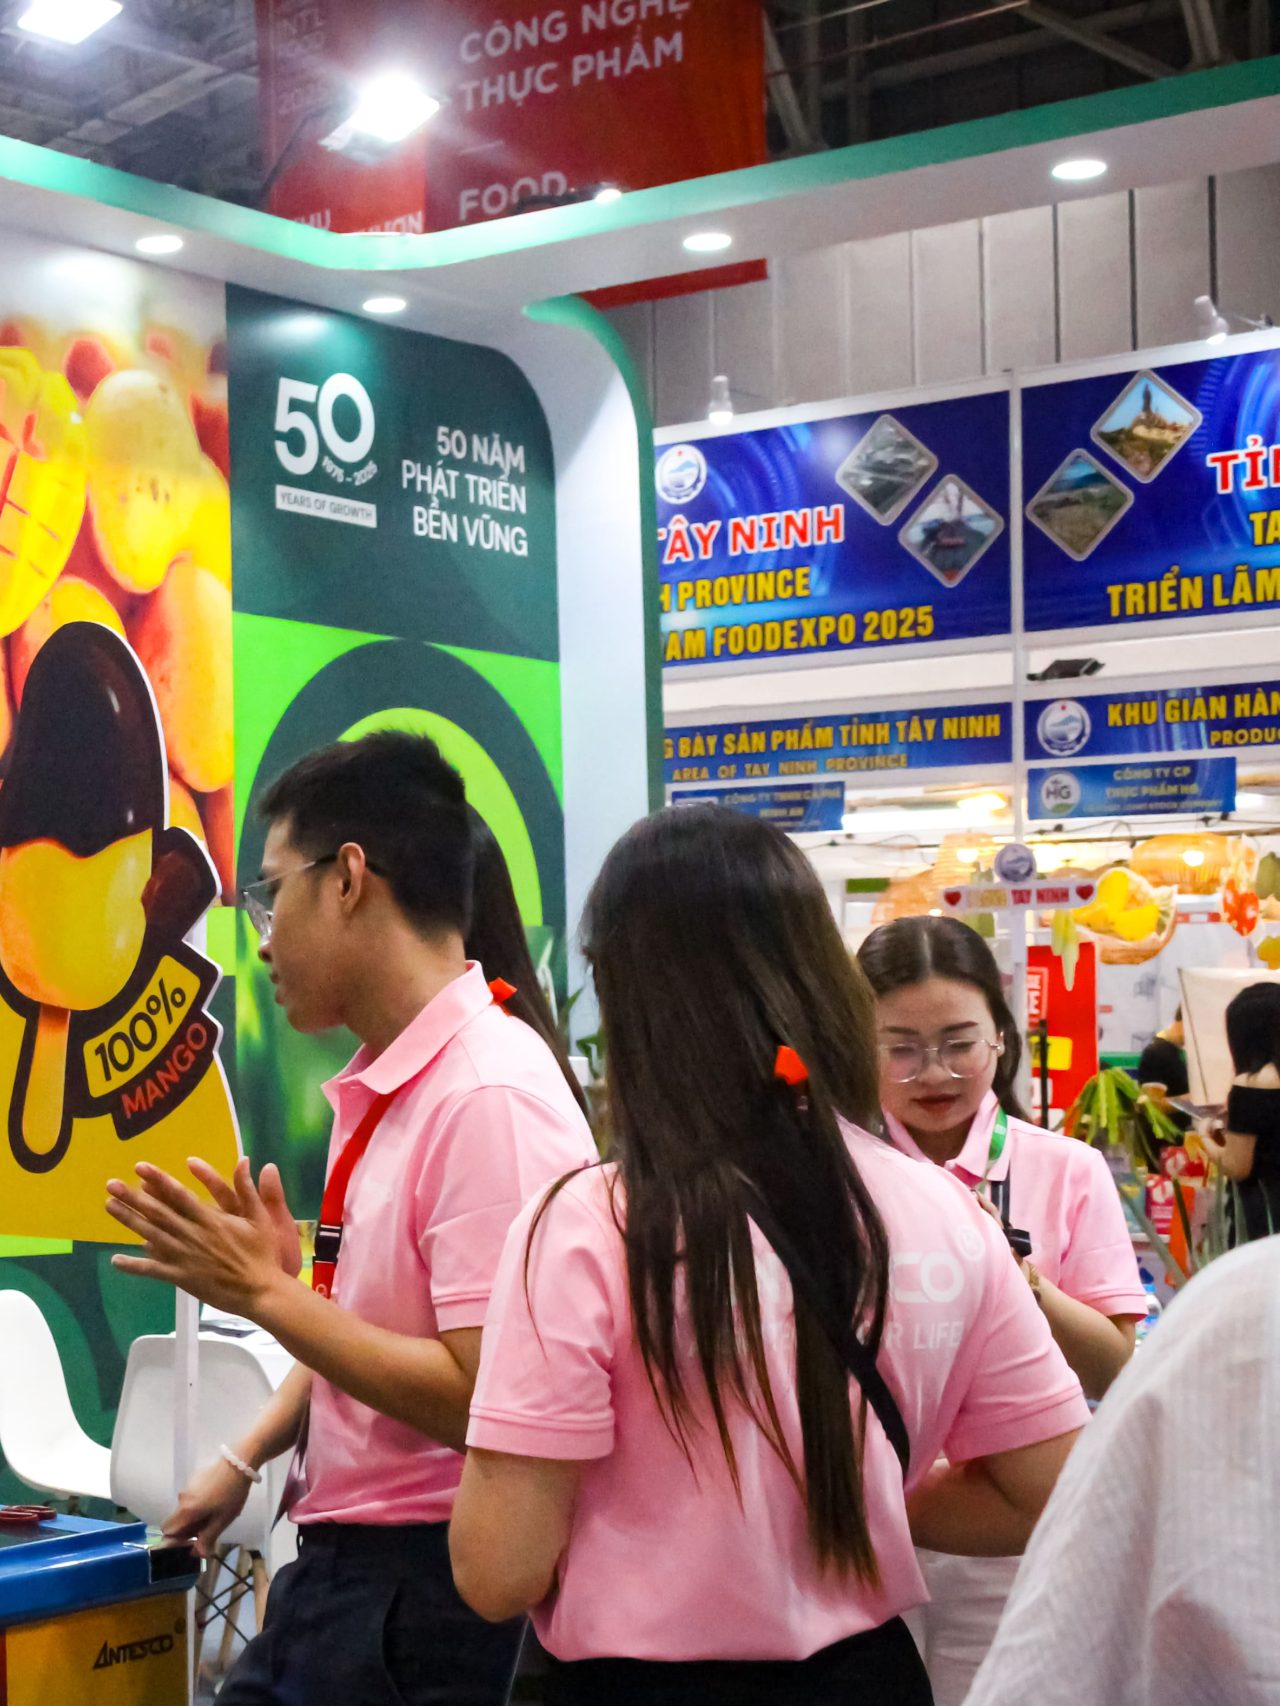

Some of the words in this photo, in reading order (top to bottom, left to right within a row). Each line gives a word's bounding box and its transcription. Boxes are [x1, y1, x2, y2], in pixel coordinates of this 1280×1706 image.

[459, 10, 567, 62] CÔNG
[459, 62, 558, 109] THỰC
[572, 24, 683, 86] PHẨM
[274, 372, 376, 475] 50
[436, 425, 467, 460] 50
[472, 432, 526, 474] NĂM
[280, 492, 311, 509] YEARS
[314, 498, 326, 510] OF
[329, 502, 373, 519] GROWTH
[402, 460, 459, 499] PHÁT
[464, 469, 527, 514] TRIỂN
[413, 496, 458, 543] BỀN
[462, 513, 529, 557] VŨNG
[657, 515, 721, 564] ÂY
[729, 504, 845, 556] NINH
[677, 566, 812, 611] PROVINCE
[1106, 564, 1204, 617] TRIỂN
[1213, 564, 1280, 607] LÃM
[713, 613, 856, 657] FOODEXPO
[863, 605, 935, 642] 2025
[678, 730, 718, 758] BÀY
[723, 725, 767, 755] SẢN
[771, 718, 834, 751] PHẨM
[839, 716, 891, 747] TỈNH
[896, 715, 937, 743] TÂY
[942, 714, 1002, 740] NINH
[1107, 701, 1158, 727] KHU
[1165, 695, 1228, 724] GIAN
[672, 766, 709, 782] AREA
[717, 764, 737, 779] OF
[744, 762, 769, 777] TAY
[779, 760, 818, 776] NINH
[826, 753, 908, 772] PROVINCE
[94, 977, 186, 1082] 100%
[121, 1022, 207, 1120] MANGO
[913, 1321, 964, 1350] LIFE
[93, 1633, 174, 1670] ANTESCO
